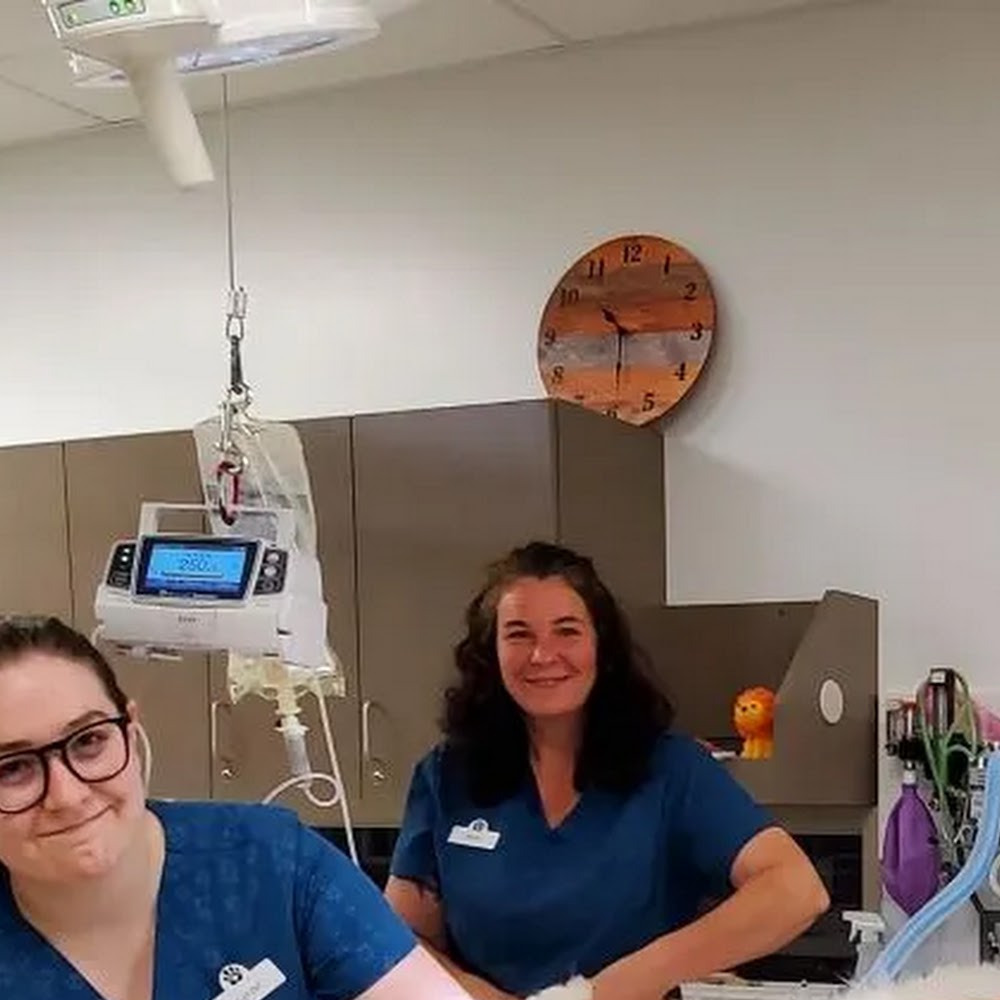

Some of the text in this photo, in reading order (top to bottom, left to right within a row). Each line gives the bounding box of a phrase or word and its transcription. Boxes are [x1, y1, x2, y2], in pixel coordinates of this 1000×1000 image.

[623, 244, 642, 263] 12
[587, 260, 604, 279] 11
[664, 255, 671, 275] 1
[560, 288, 579, 307] 10
[684, 282, 698, 301] 2
[544, 328, 556, 346] 9
[690, 322, 703, 341] 3
[552, 365, 564, 384] 8
[674, 362, 686, 381] 4
[642, 392, 654, 412] 5
